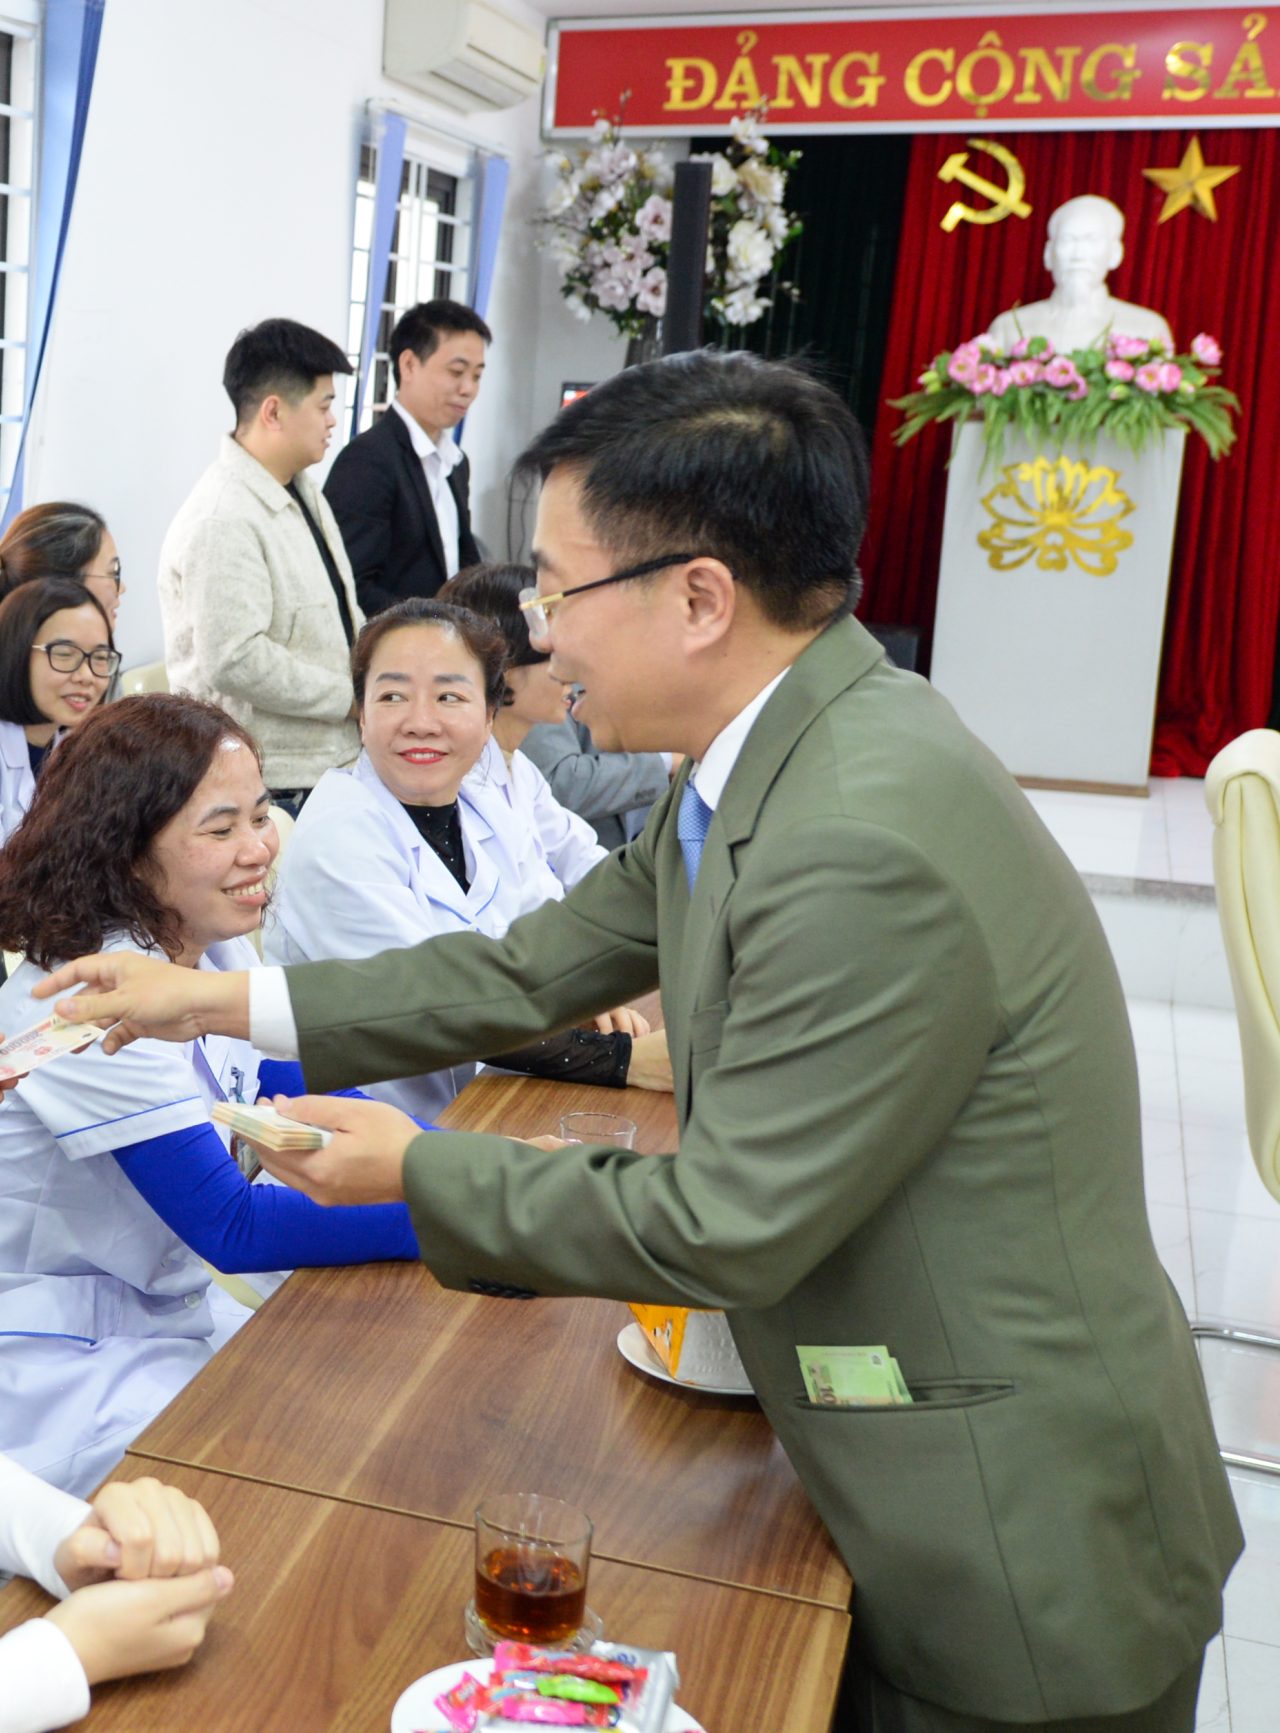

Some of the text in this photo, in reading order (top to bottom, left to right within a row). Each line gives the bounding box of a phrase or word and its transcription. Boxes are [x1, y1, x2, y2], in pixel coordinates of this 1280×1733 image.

[662, 12, 1280, 119] ĐẢNG CỘNG SẢ
